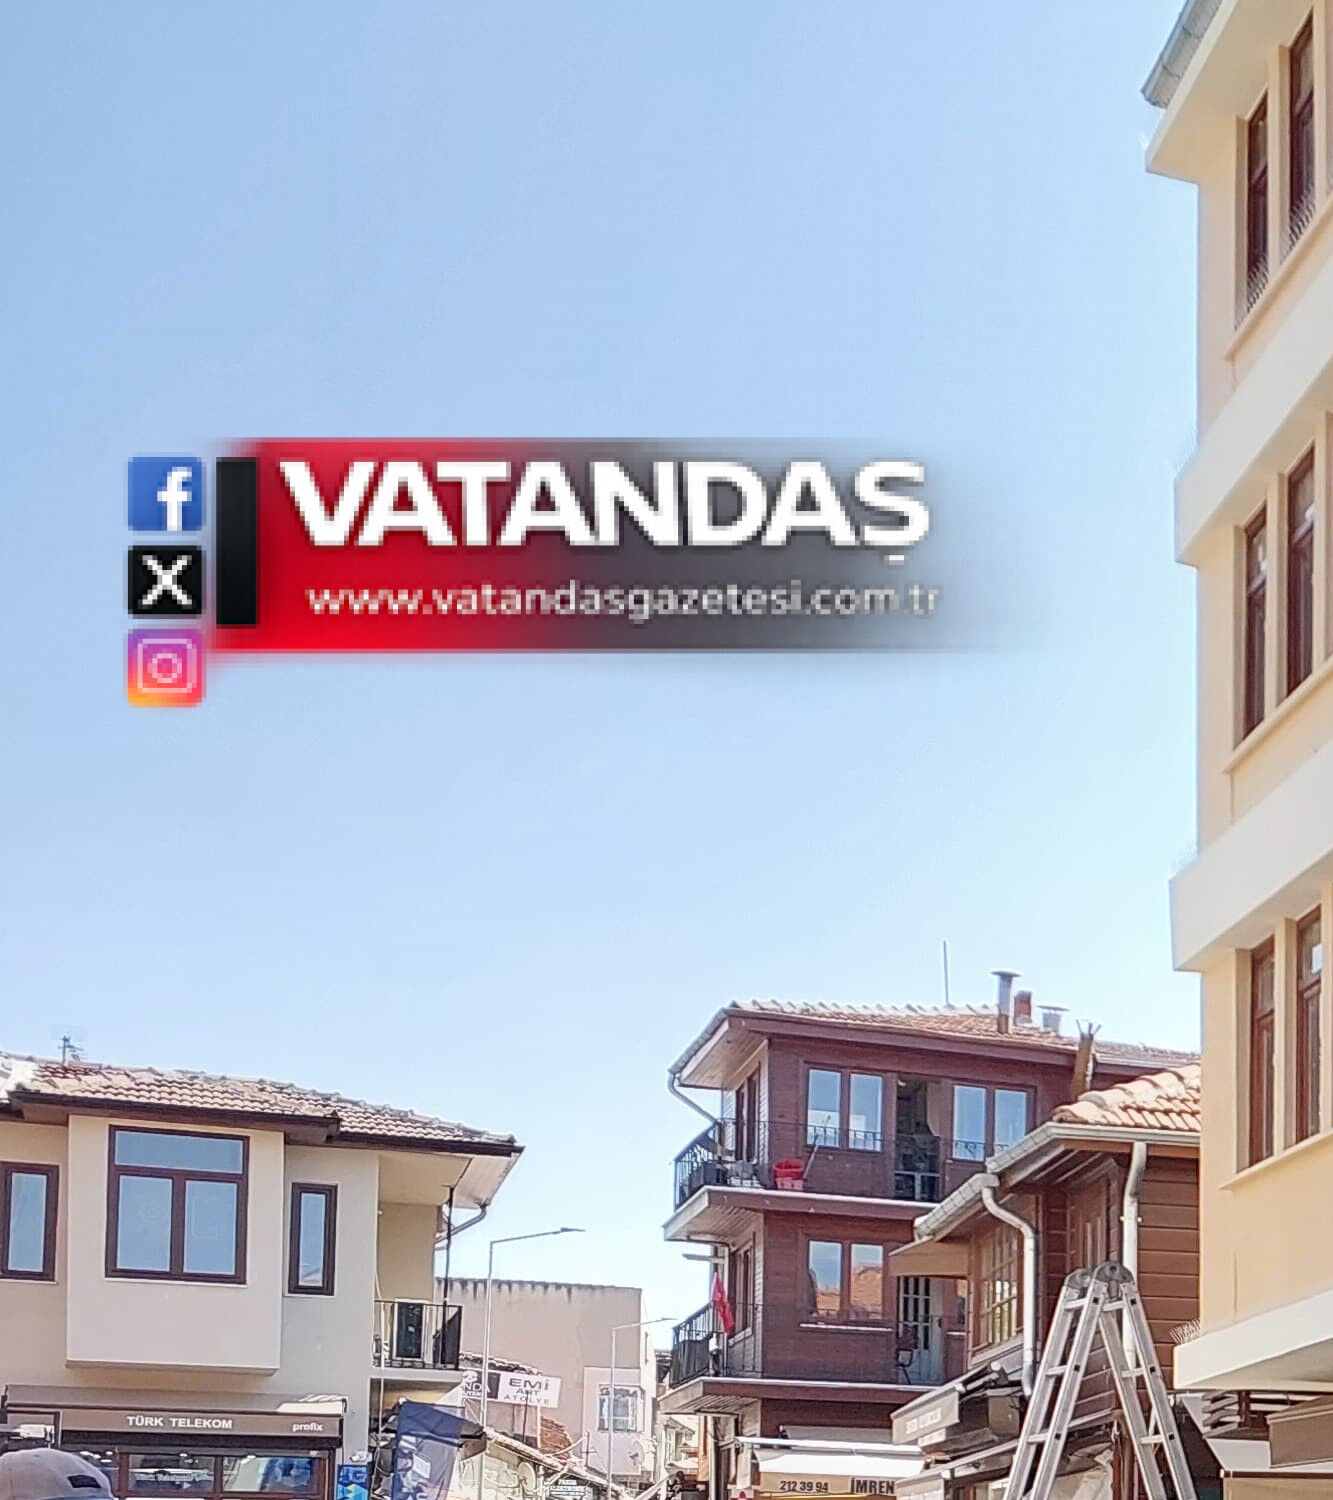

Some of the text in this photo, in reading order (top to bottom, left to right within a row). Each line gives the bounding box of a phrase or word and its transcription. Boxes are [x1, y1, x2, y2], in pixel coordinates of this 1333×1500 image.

[127, 1415, 233, 1430] TÜRK TELEKOM
[292, 1422, 324, 1432] profix
[780, 1480, 829, 1492] 212 39 94
[850, 1476, 895, 1495] İMREN
